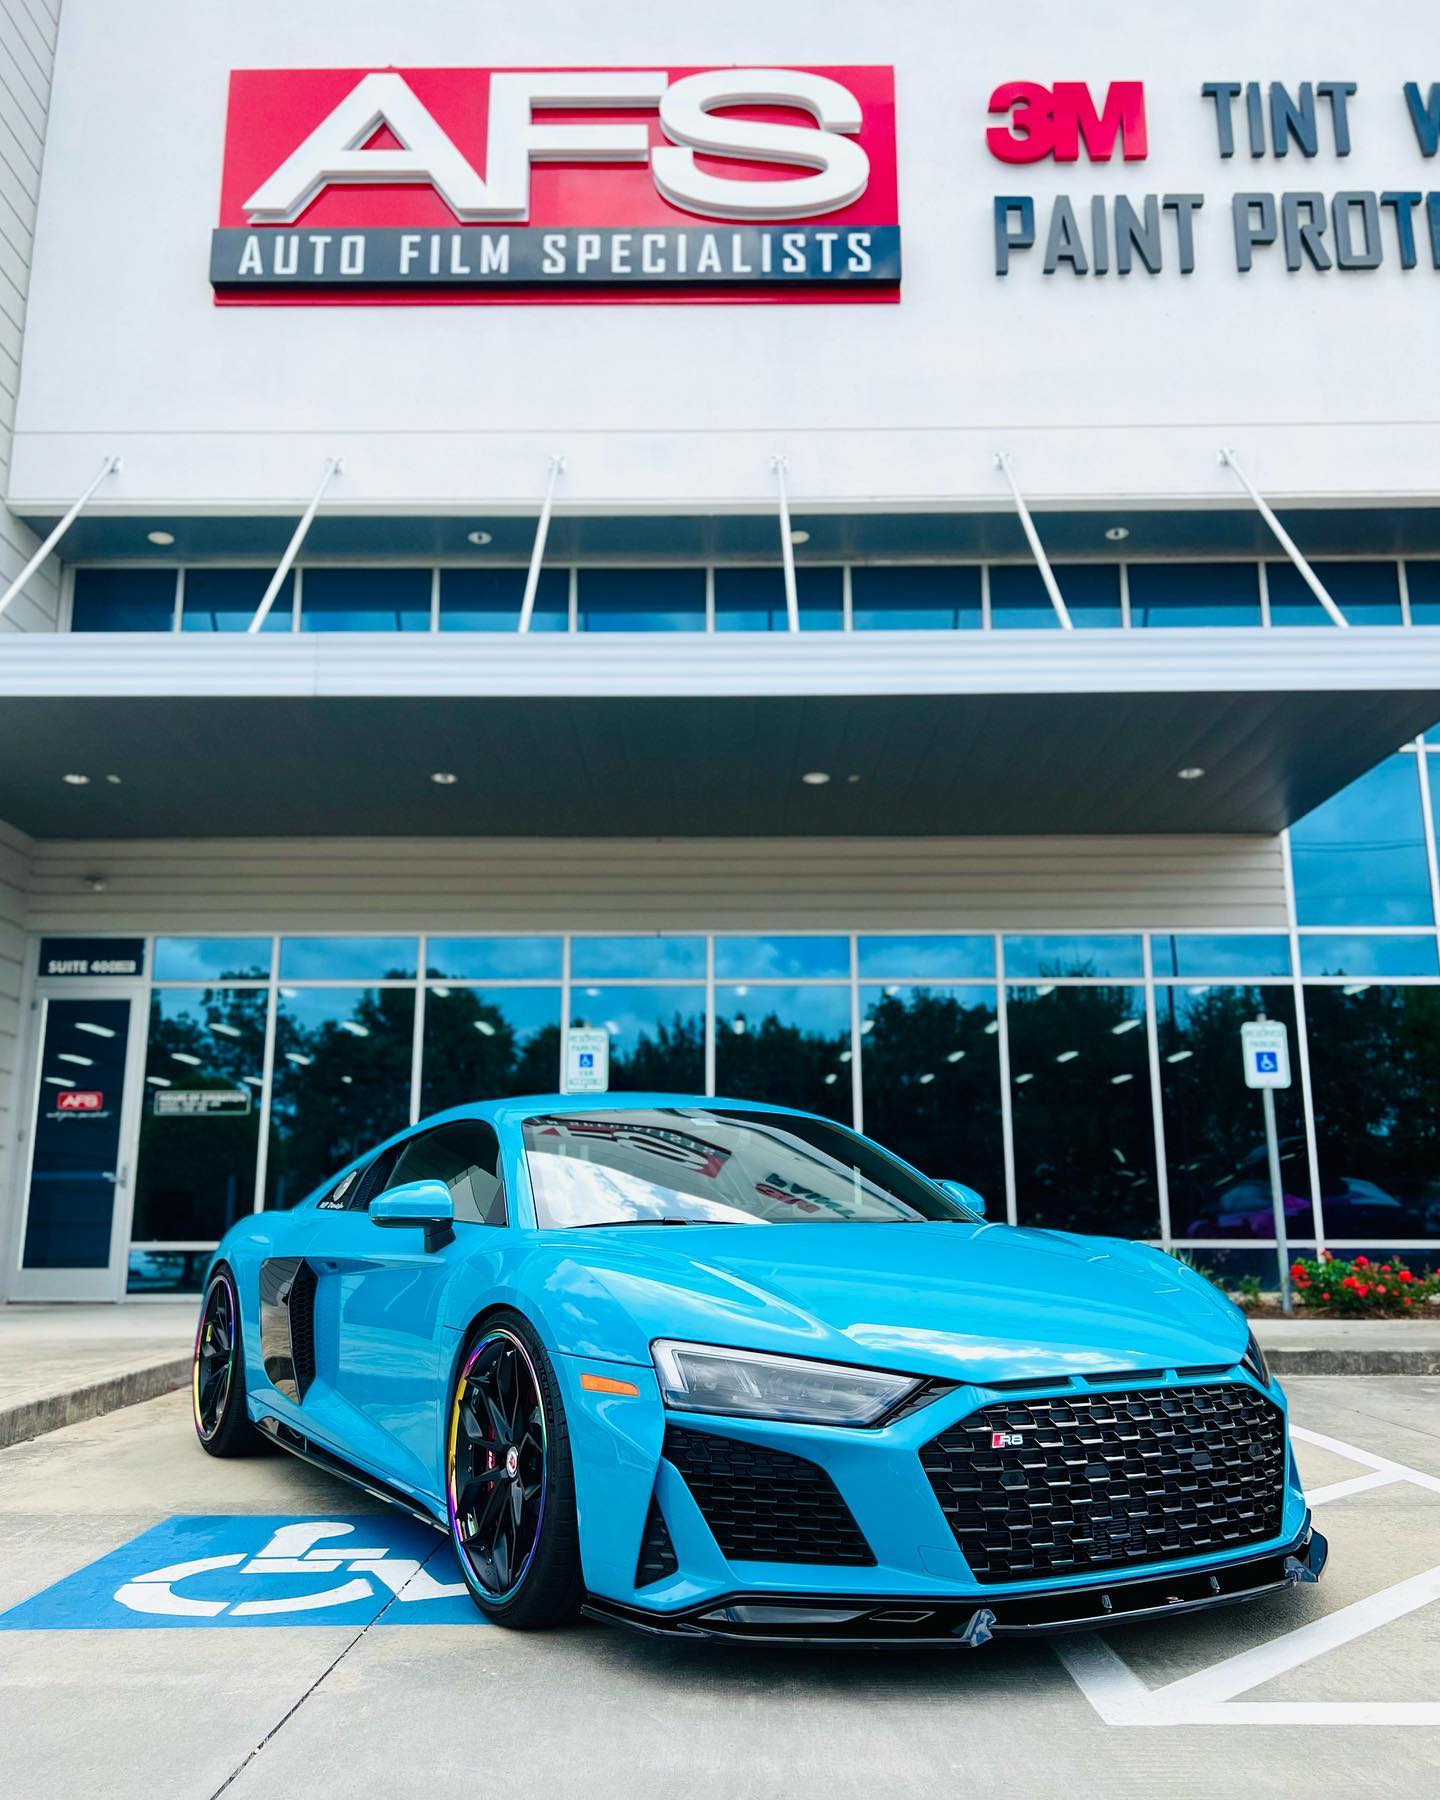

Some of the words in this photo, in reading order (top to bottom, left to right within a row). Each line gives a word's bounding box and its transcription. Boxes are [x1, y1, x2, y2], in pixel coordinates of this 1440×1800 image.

[242, 67, 870, 223] AFS
[985, 80, 1149, 165] 3M
[1201, 81, 1357, 159] TINT
[237, 235, 366, 275] AUTO
[400, 234, 511, 275] FILM
[541, 231, 874, 274] SPECIALISTS
[993, 193, 1205, 276] PAINT
[48, 960, 88, 974] SUITE
[993, 1433, 1023, 1447] R8
